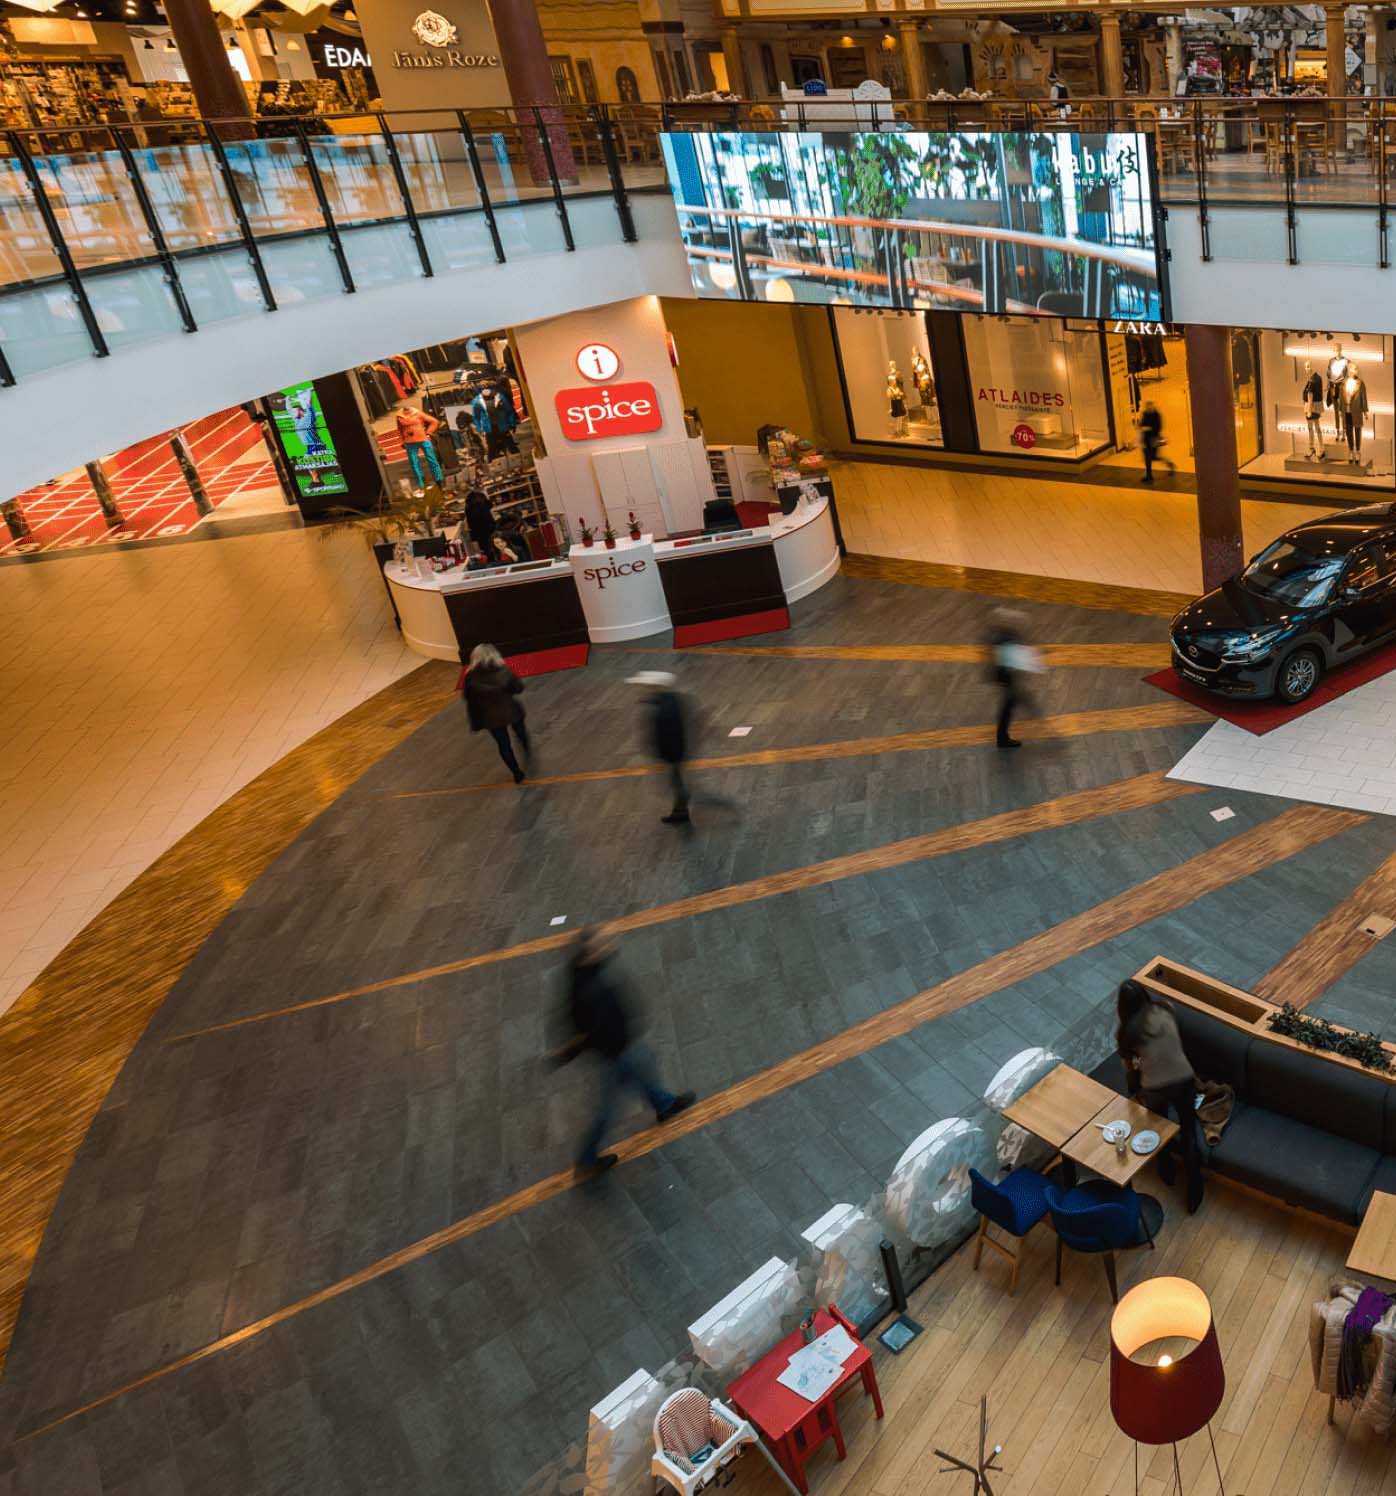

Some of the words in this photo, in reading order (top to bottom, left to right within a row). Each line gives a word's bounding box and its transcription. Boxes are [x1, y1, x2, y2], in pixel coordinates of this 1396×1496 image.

[324, 44, 371, 67] ĒDA
[392, 50, 443, 68] Jānis
[448, 51, 497, 67] Roze
[1113, 321, 1167, 335] ZARA
[978, 388, 1065, 407] ATLAIDES
[567, 390, 651, 434] spice
[584, 557, 646, 589] spice
